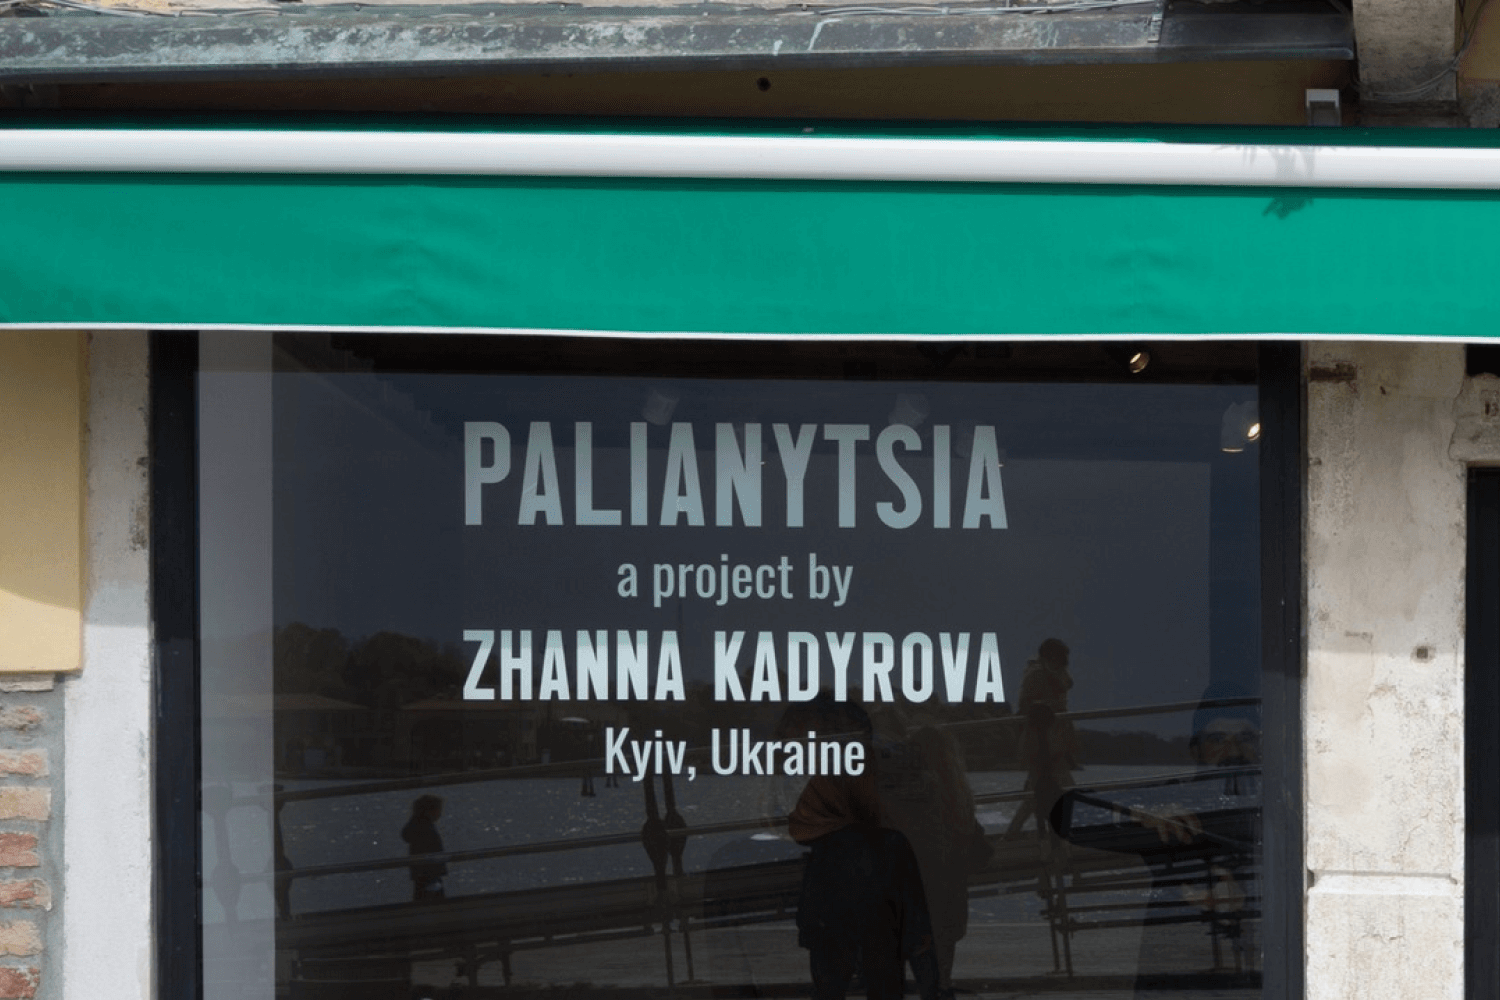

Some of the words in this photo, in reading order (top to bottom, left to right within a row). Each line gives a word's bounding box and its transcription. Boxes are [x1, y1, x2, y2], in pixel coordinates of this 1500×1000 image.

[463, 421, 1008, 529] PALIANYTSIA
[617, 562, 638, 598] a
[653, 553, 793, 607] project
[808, 552, 854, 606] by
[462, 629, 686, 700] ZHANNA
[714, 630, 1006, 702] KADYROVA
[604, 727, 697, 781] Kyiv,
[711, 728, 865, 777] Ukraine
